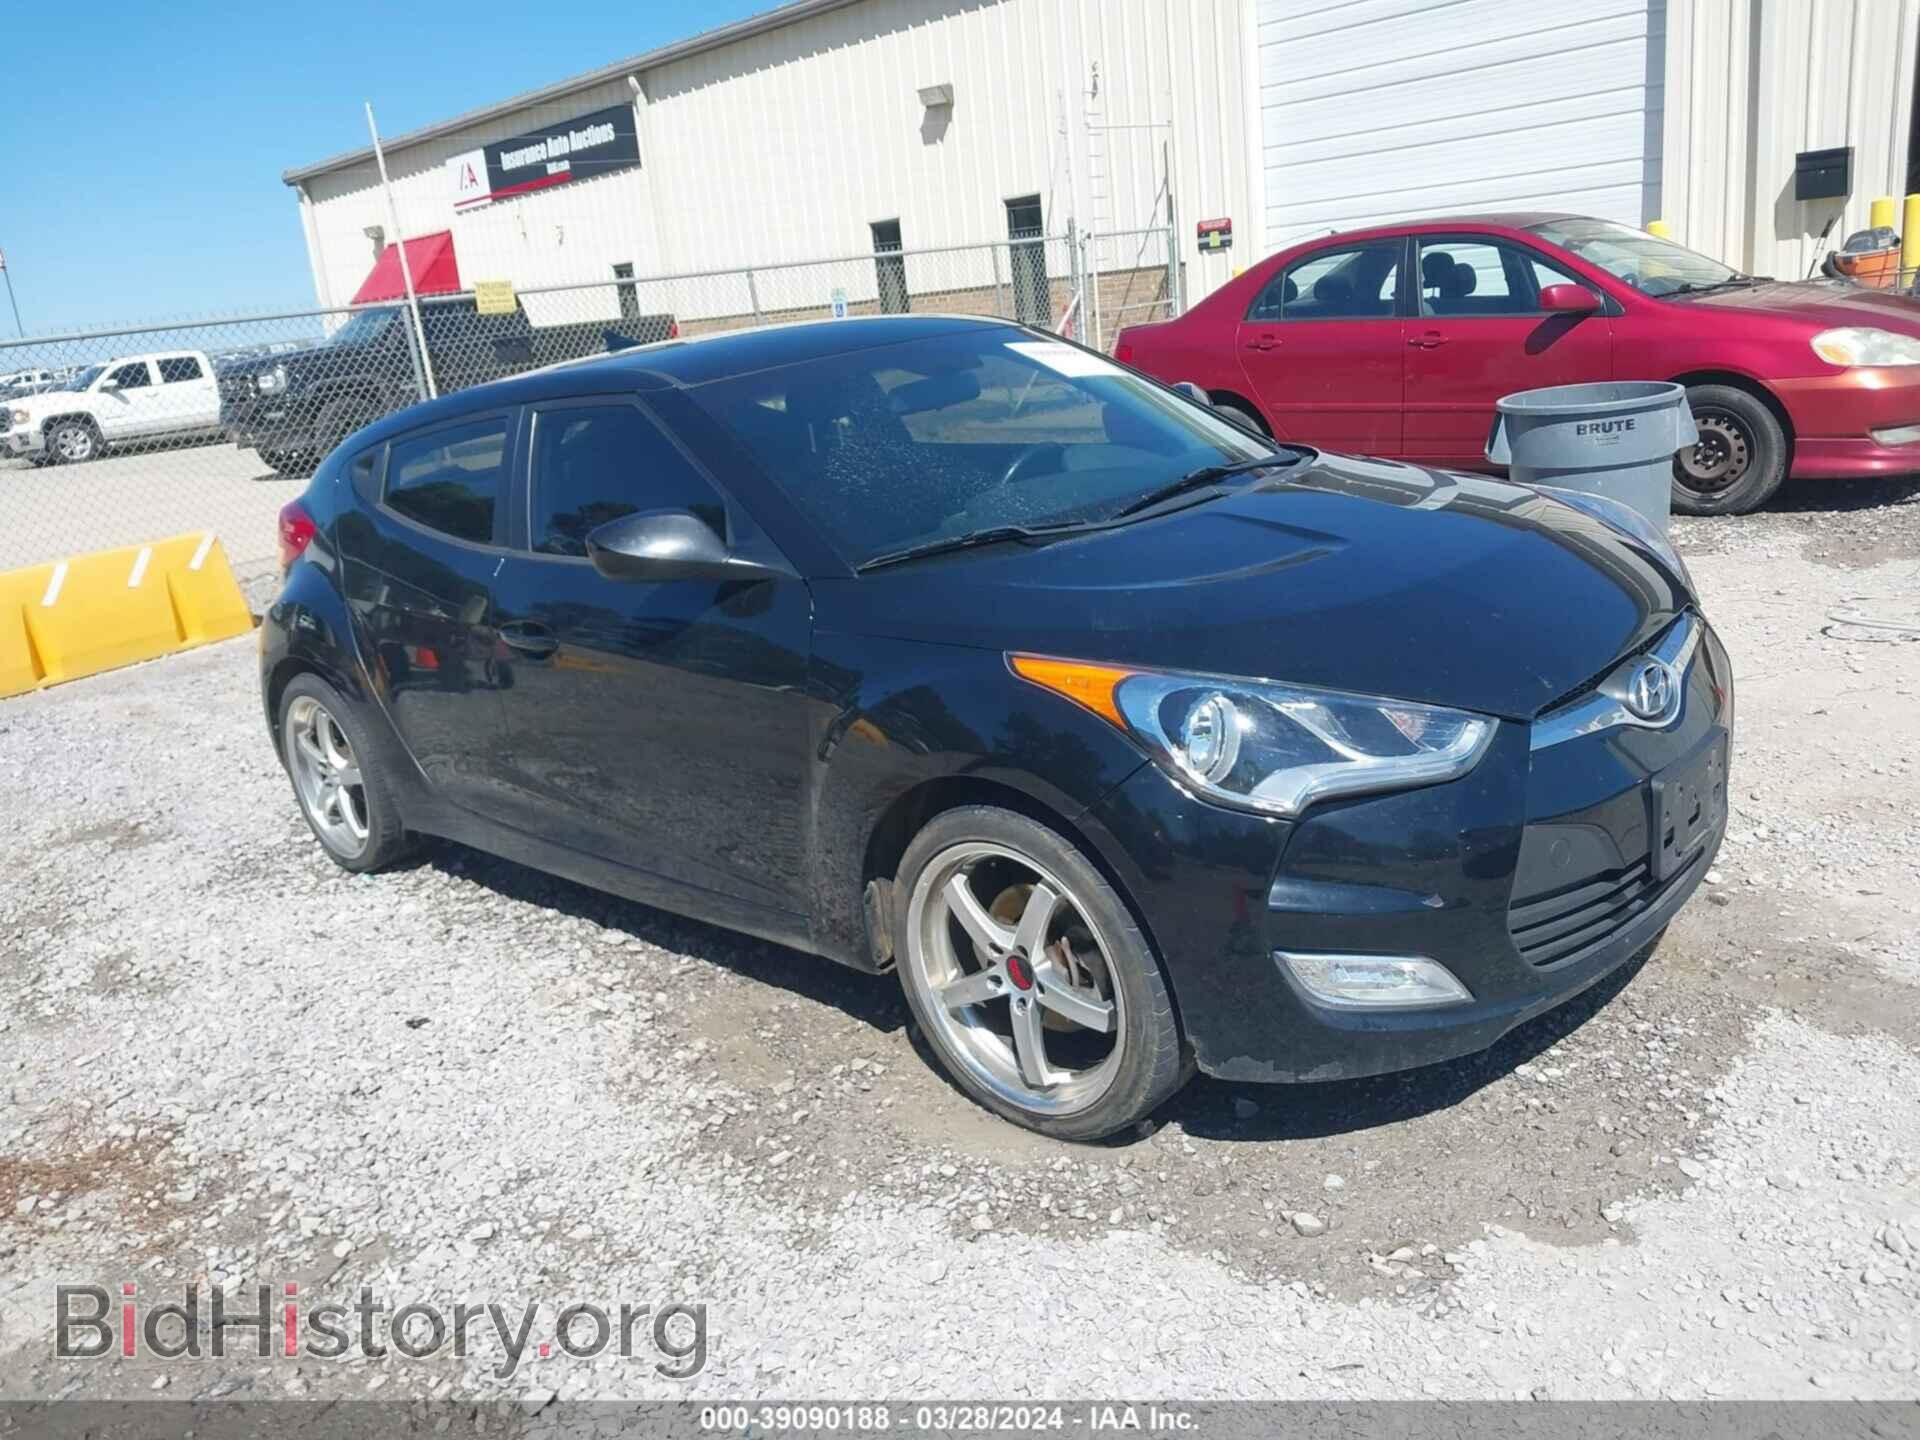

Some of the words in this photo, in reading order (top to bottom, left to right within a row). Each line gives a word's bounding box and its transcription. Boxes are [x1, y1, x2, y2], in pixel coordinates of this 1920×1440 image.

[500, 143, 547, 171] Insurance
[546, 135, 570, 158] Auto
[569, 122, 616, 152] Auctions
[1576, 418, 1635, 436] BRUTE
